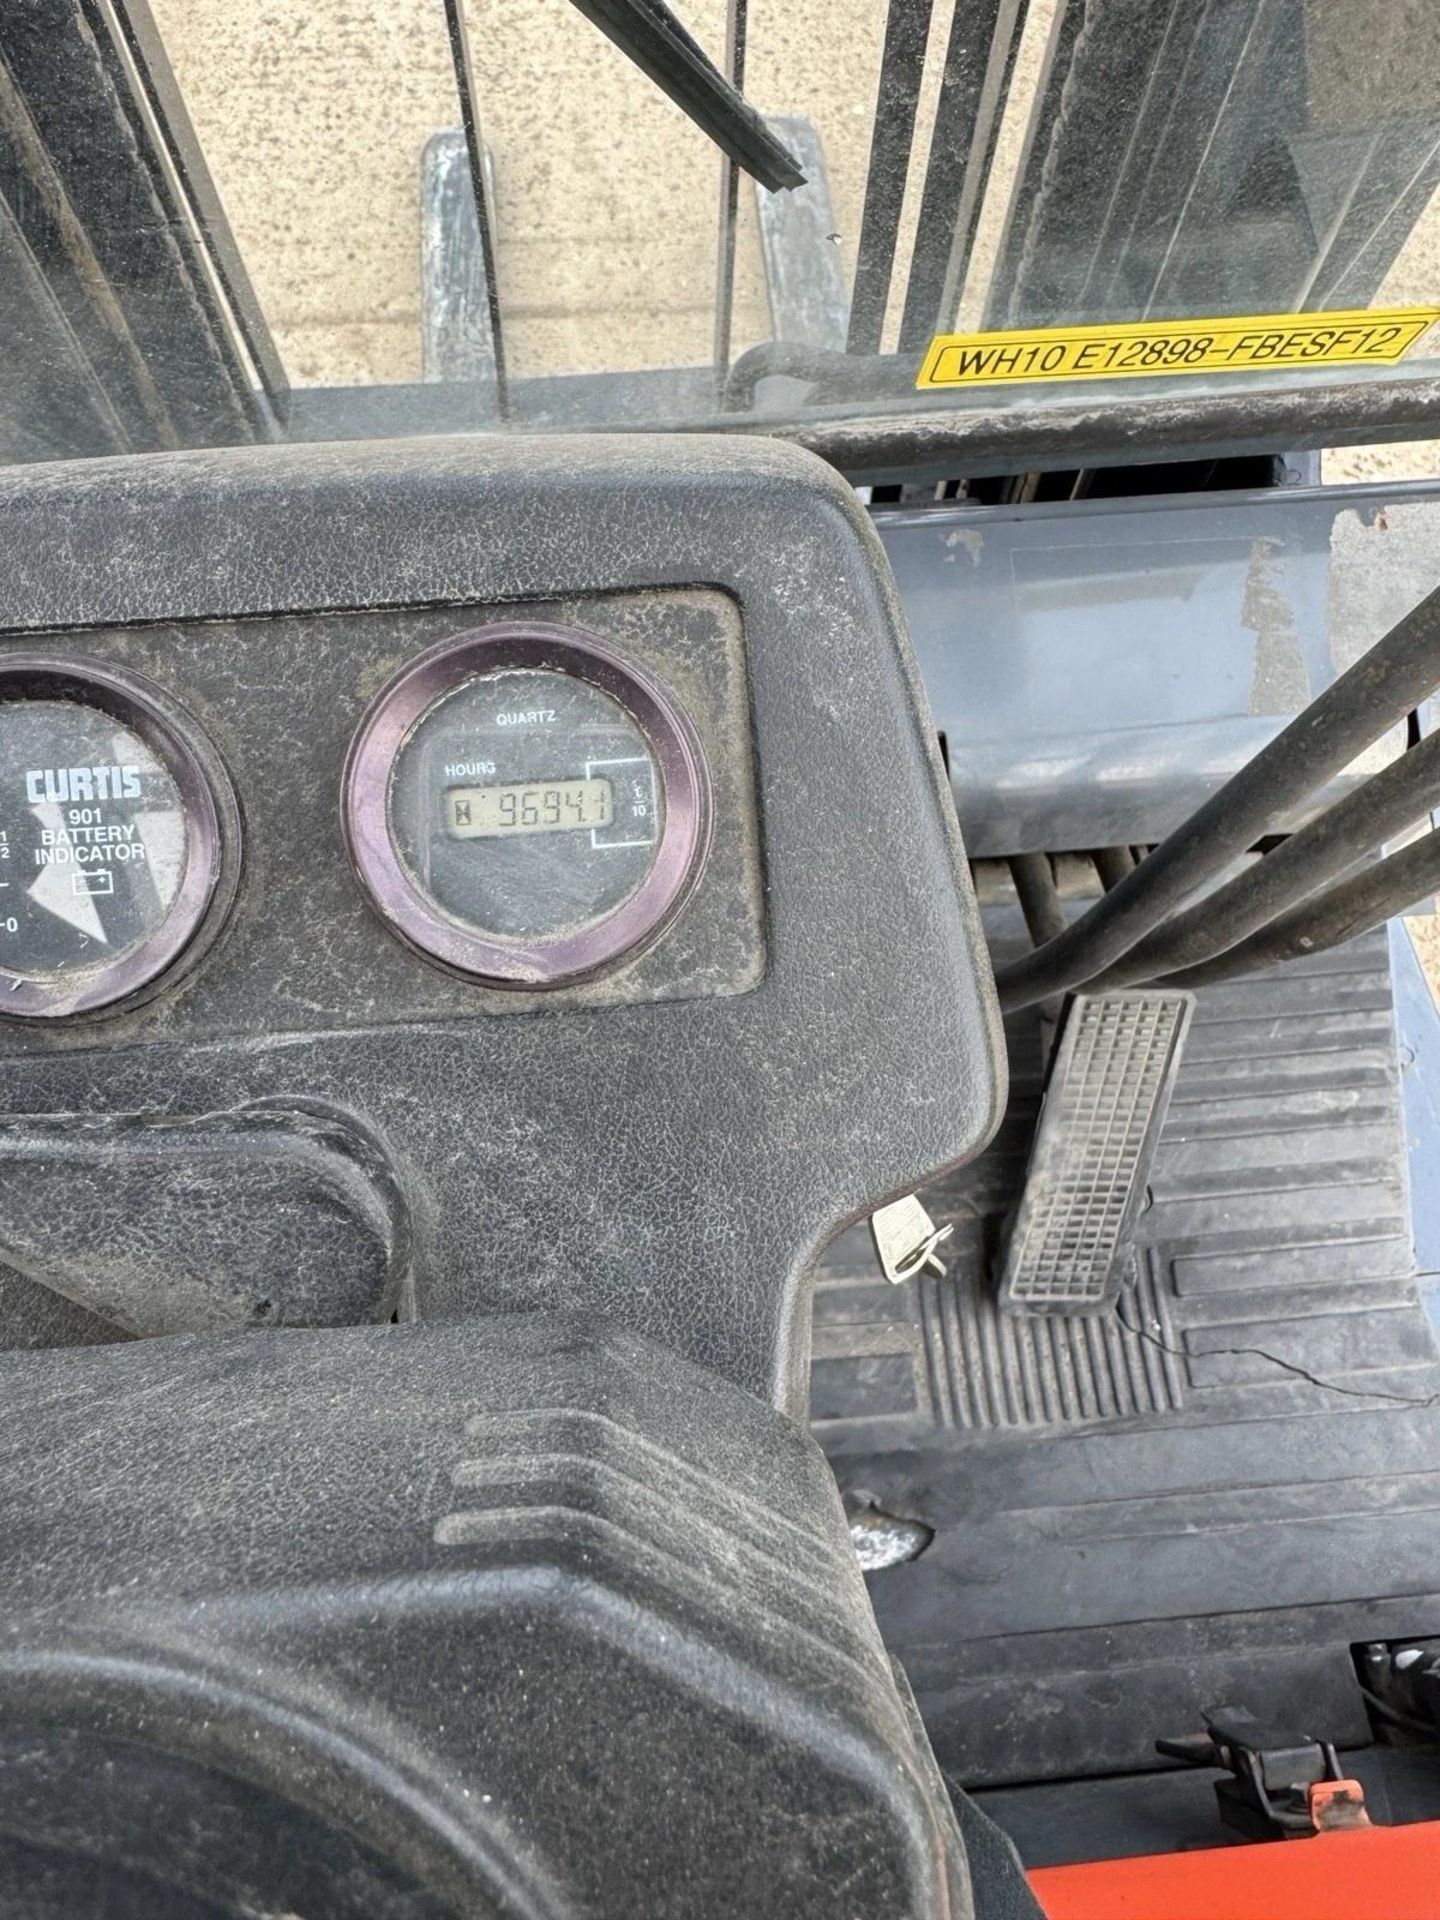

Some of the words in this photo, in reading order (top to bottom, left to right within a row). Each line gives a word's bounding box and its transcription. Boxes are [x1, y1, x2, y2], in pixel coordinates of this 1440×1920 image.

[959, 345, 1066, 375] WH10
[1072, 327, 1402, 369] E12898-FBESF12
[496, 710, 556, 726] QUARTZ
[445, 762, 496, 777] HOURS
[26, 765, 142, 803] CURTIS
[69, 808, 102, 825] 901
[41, 824, 134, 846] BATTERY
[35, 843, 145, 864] INDICATOR
